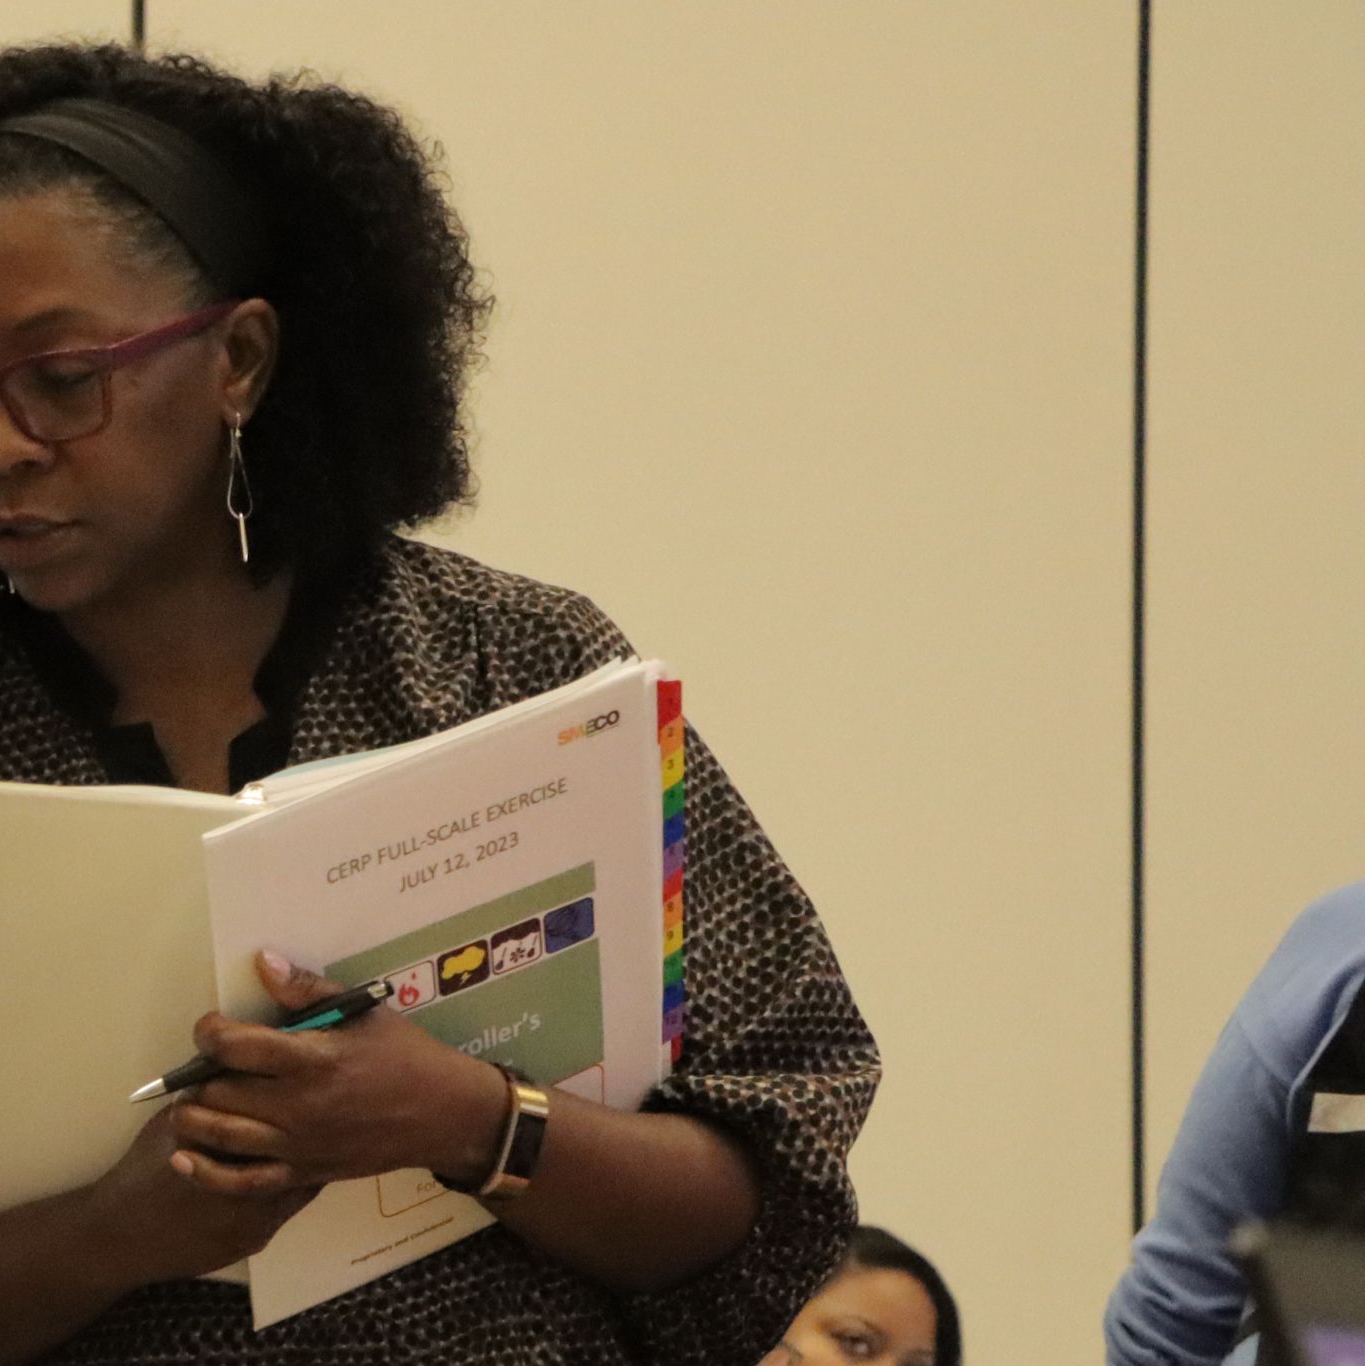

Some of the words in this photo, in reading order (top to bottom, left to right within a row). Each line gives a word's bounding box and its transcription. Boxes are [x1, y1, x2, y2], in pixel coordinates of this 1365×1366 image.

[326, 854, 372, 885] CERP
[377, 812, 482, 866] FULL-SCALE
[486, 777, 569, 823] EXERCISE
[399, 864, 439, 893] JULY
[444, 852, 471, 874] 12,
[475, 831, 520, 861] 2023
